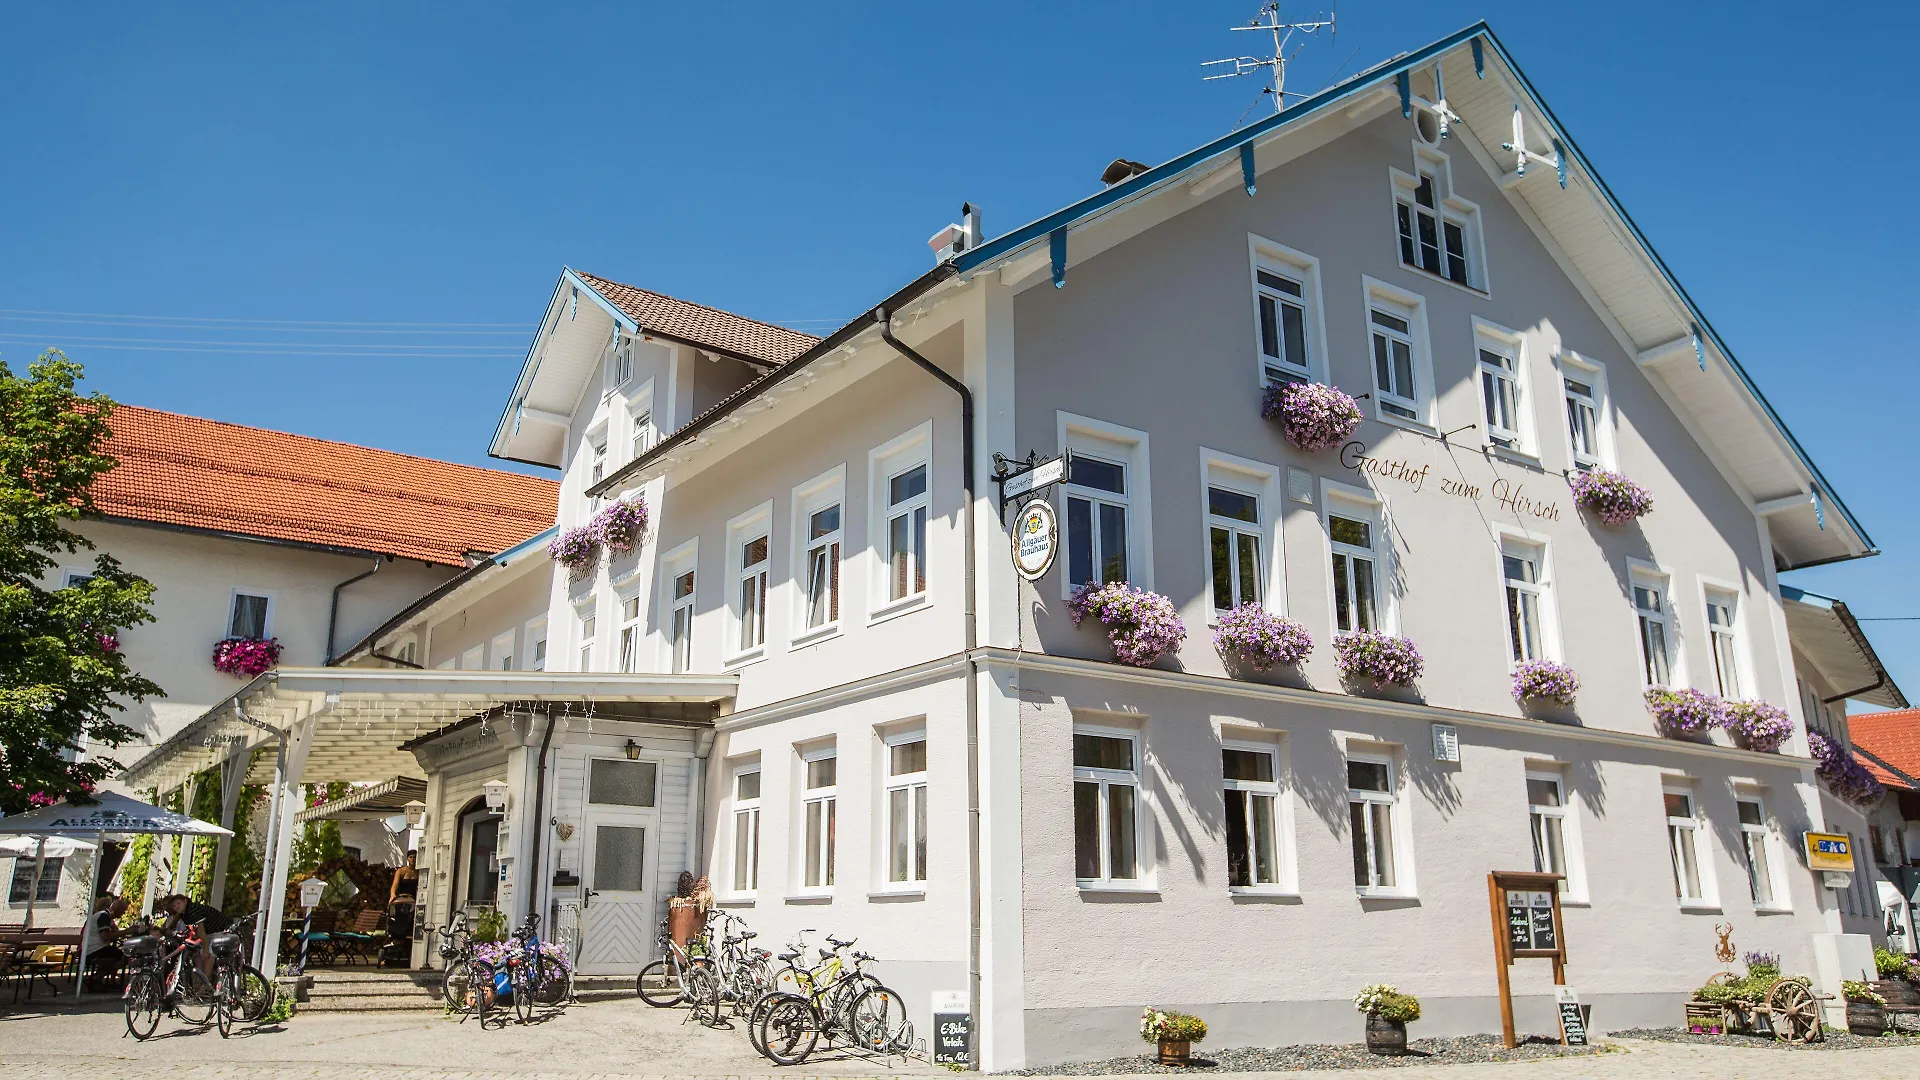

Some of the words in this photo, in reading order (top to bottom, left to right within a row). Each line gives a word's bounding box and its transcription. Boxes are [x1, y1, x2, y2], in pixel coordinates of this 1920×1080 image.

[1340, 441, 1430, 493] Gasthof
[1441, 477, 1483, 501] zum
[1492, 478, 1561, 522] Hirsch
[1021, 534, 1048, 549] Allgäuer
[1020, 543, 1049, 558] Brauhaus
[551, 816, 557, 826] 6
[940, 1021, 968, 1035] E-Bike
[942, 1036, 965, 1047] Verleih
